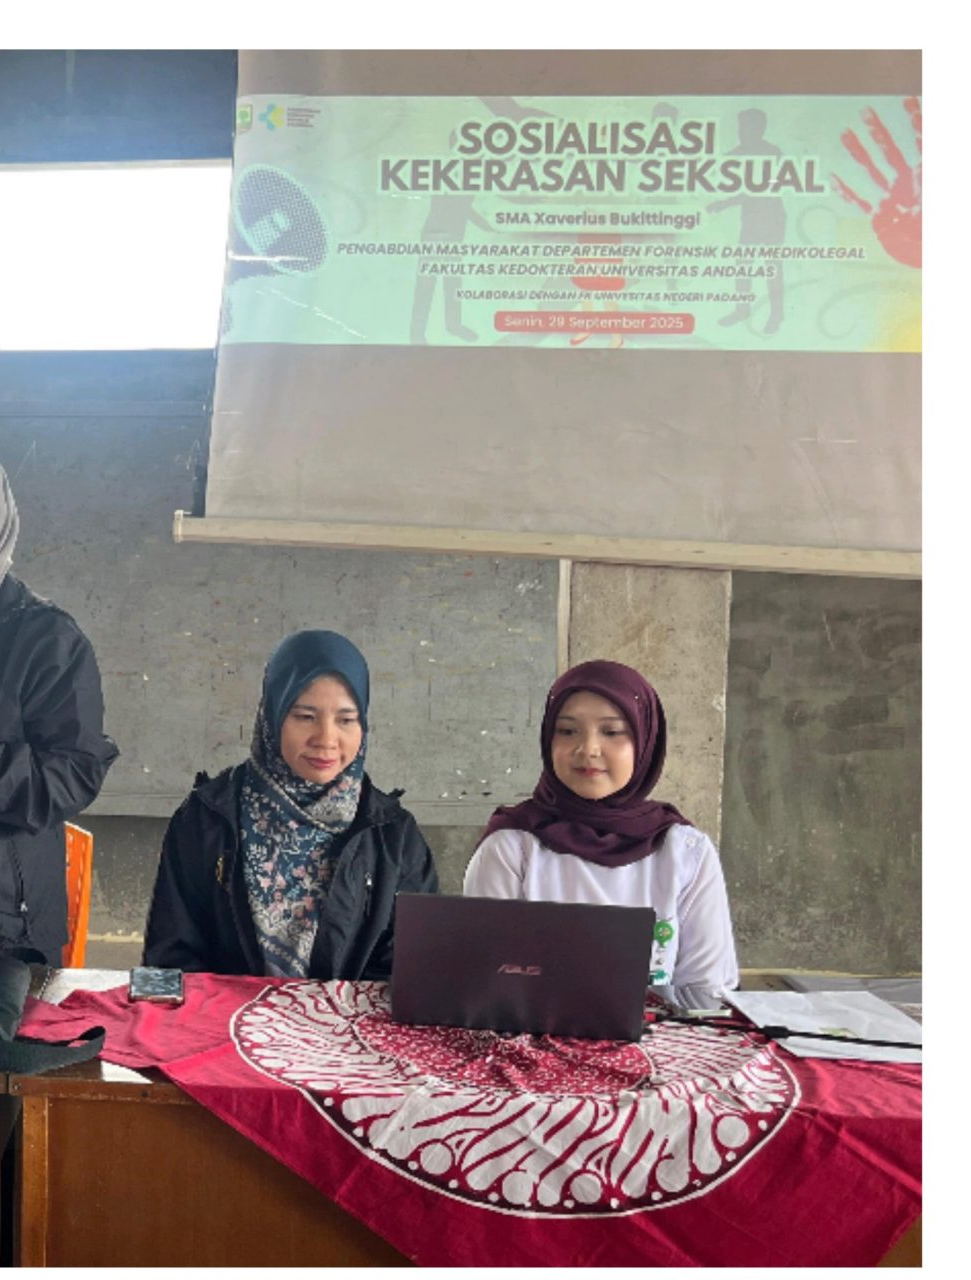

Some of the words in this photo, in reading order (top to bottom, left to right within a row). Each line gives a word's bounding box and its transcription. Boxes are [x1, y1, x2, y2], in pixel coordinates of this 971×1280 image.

[457, 121, 716, 155] SOSIALISASI
[380, 159, 626, 192] KEKERASAN
[637, 159, 825, 193] SEKSUAL
[495, 212, 530, 225] SMA
[534, 211, 606, 226] Xaverius
[610, 211, 700, 230] Bukittinggi
[337, 243, 432, 256] PENGABDIAN
[435, 244, 540, 257] MASYARAKAT
[542, 244, 641, 258] DEPARTEMEN
[644, 245, 718, 258] FORENSIK
[721, 246, 757, 259] DAN
[758, 247, 866, 260] MEDIKOLEGAL
[420, 263, 496, 276] FAKULTAS
[498, 263, 597, 276] KEDOKTERAN
[601, 264, 699, 278] UNIVERSITAS
[702, 265, 775, 278] ANDALAS
[456, 290, 528, 300] KOLABORASI
[528, 290, 577, 301] DENGAN
[663, 292, 705, 303] NEGERI
[568, 315, 646, 330] September
[649, 316, 685, 329] 2025
